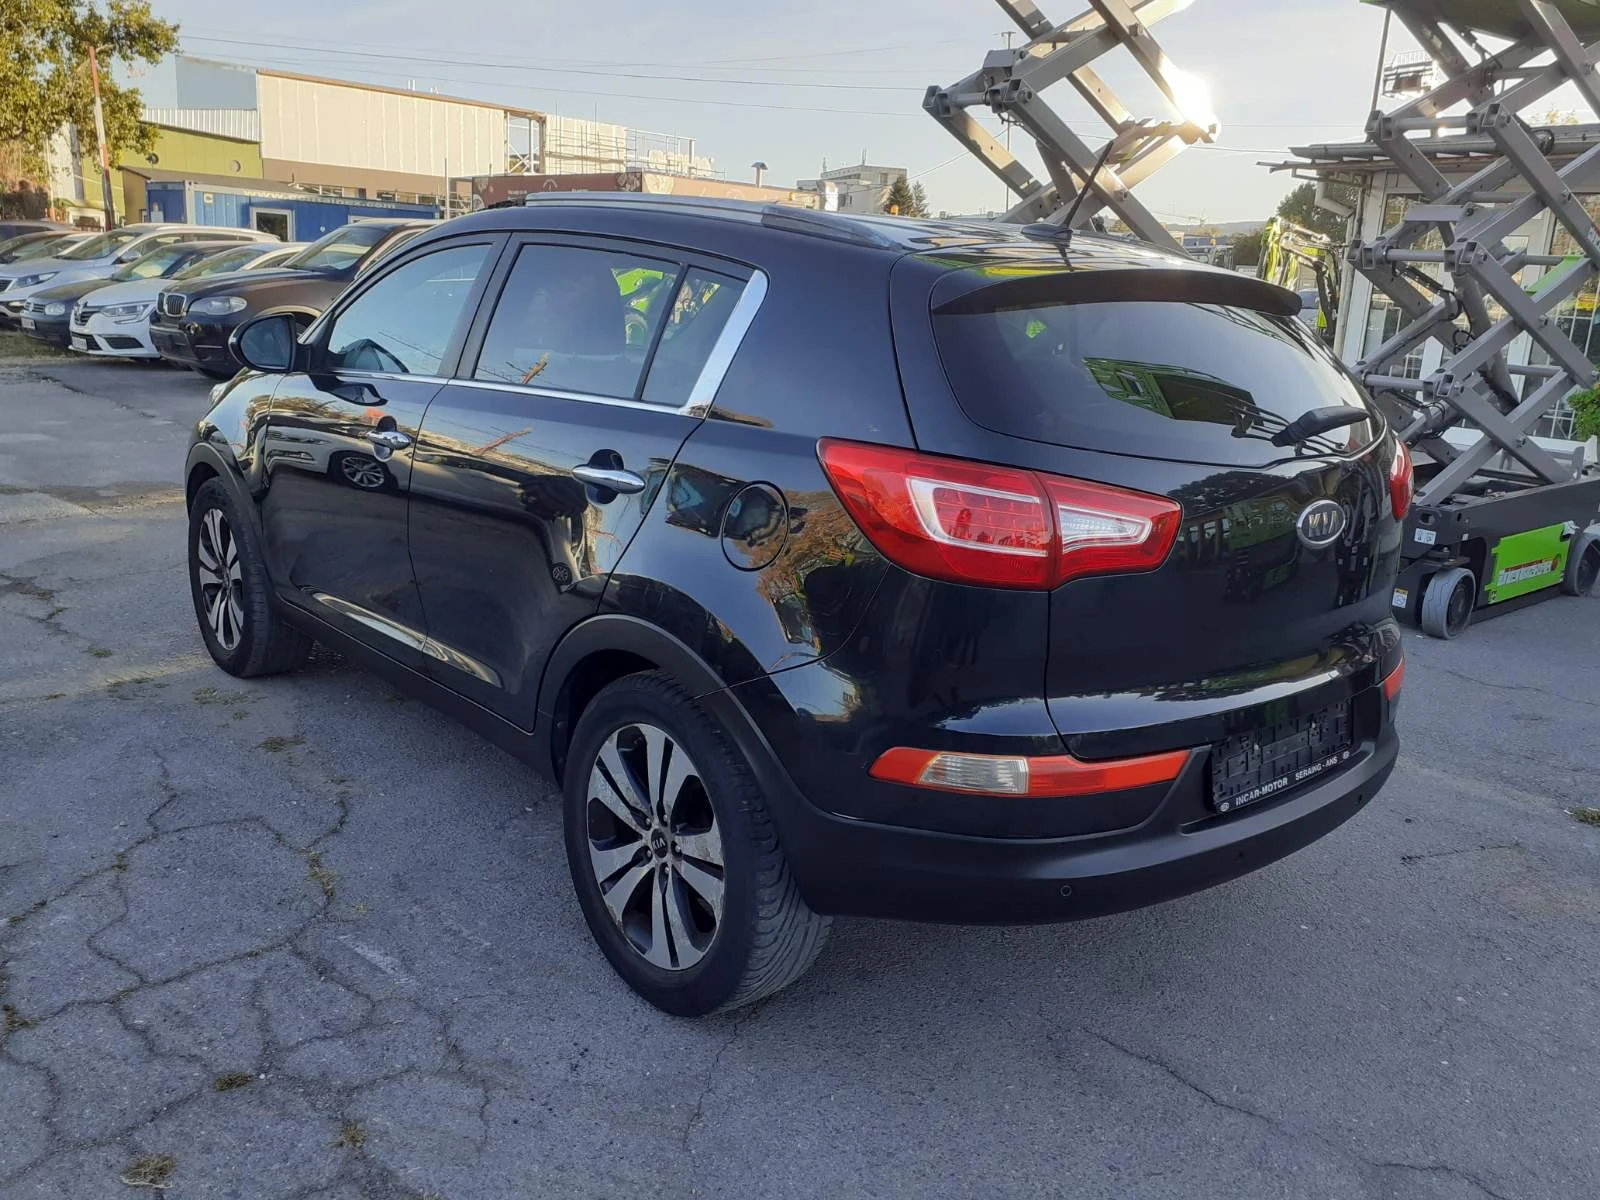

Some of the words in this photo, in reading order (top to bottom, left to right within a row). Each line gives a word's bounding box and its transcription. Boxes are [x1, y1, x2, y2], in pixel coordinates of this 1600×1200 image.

[1308, 510, 1340, 538] KIA
[1235, 777, 1289, 806] INCAR-MOTOR
[1325, 756, 1338, 768] ANS
[652, 837, 666, 851] KIA
